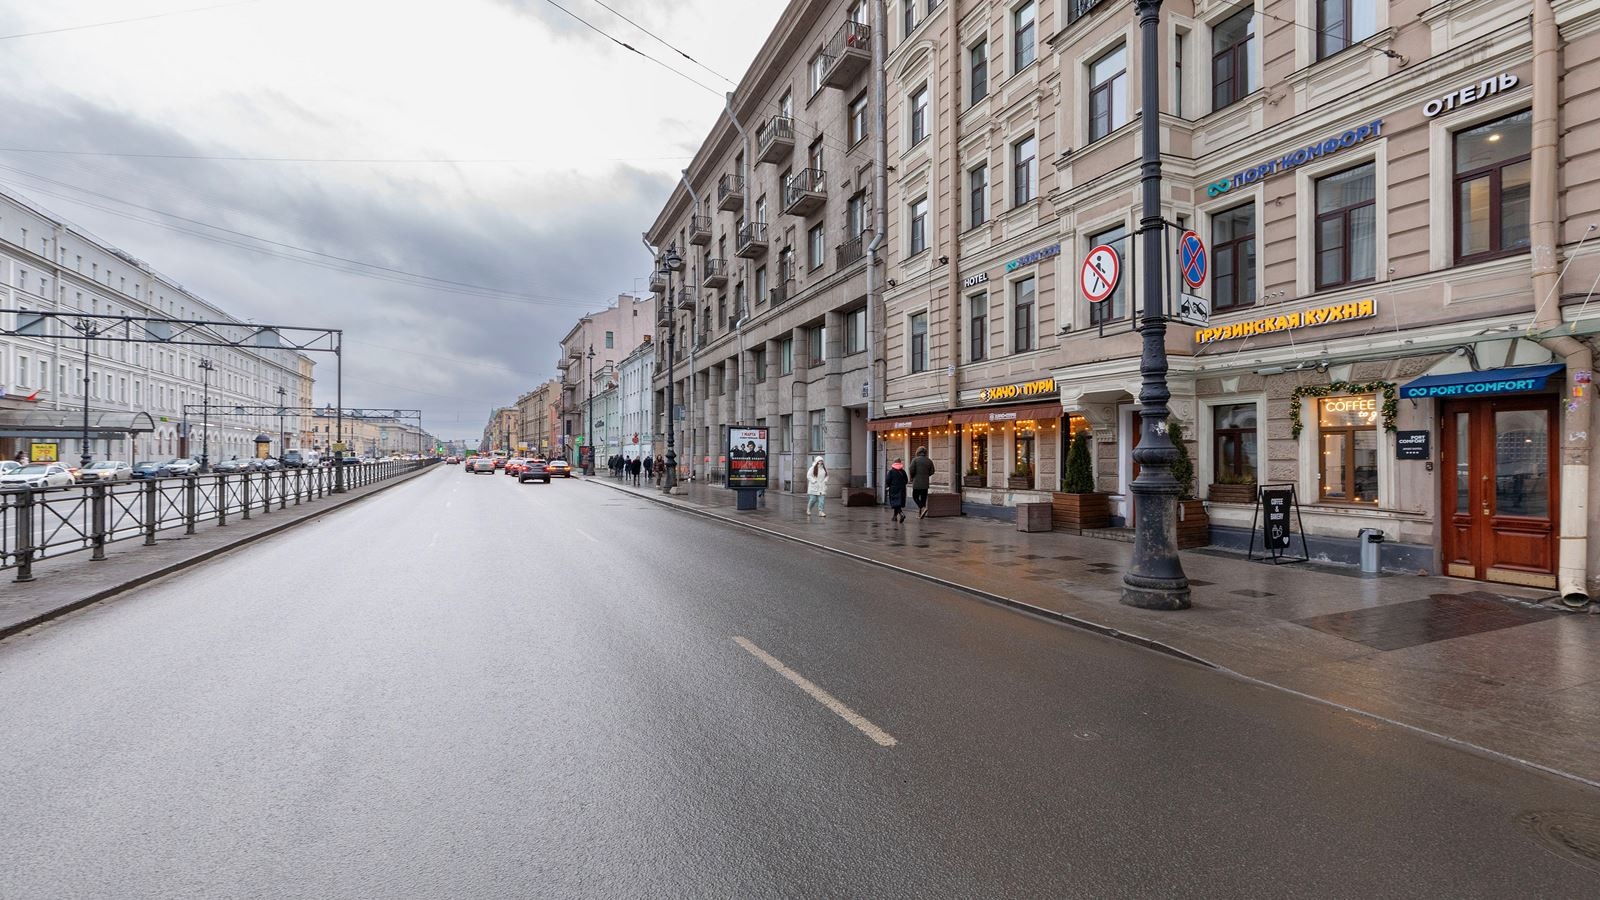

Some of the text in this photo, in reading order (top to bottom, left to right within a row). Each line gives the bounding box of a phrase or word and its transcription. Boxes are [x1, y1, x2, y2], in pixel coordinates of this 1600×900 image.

[1422, 73, 1519, 118] ОТЕЛЬ
[1233, 119, 1384, 187] ПОРТ КОМФОРТ
[964, 272, 988, 287] HOTEL
[1195, 298, 1377, 344] ГРУЗИНСКАЯ КУХНЯ
[1024, 379, 1057, 395] ПУРИ
[1429, 379, 1536, 396] PORT COMFORT
[1326, 399, 1376, 412] COFFEE
